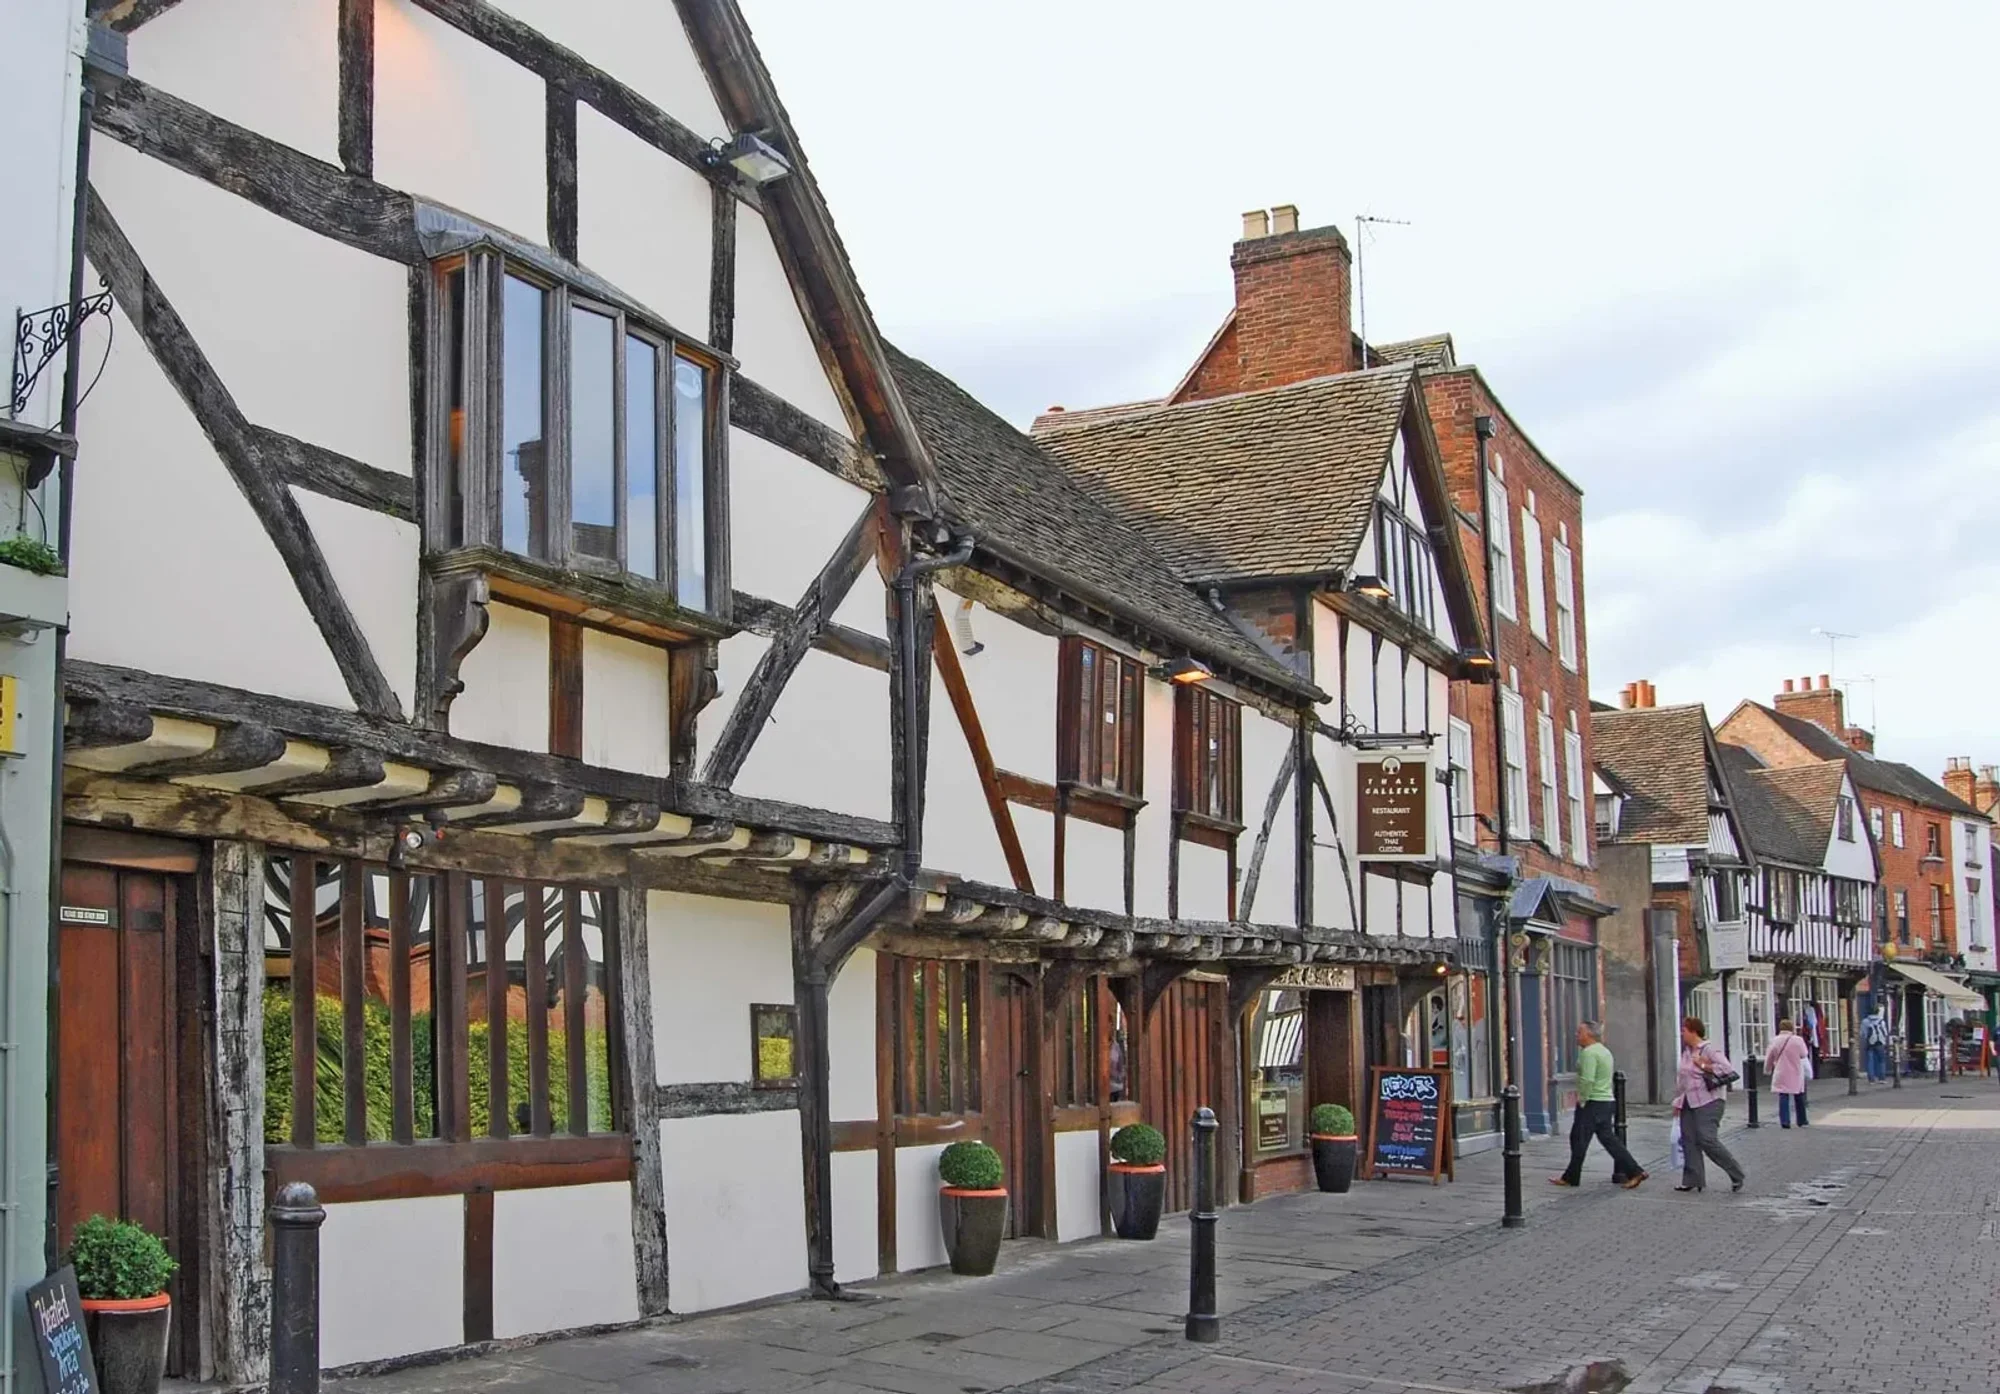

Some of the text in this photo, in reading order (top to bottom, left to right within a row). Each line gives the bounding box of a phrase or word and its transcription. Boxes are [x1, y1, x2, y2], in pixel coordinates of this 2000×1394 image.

[1365, 787, 1418, 795] GALLERY
[1374, 830, 1409, 838] AUTHENTIC
[34, 1284, 70, 1336] Heated
[47, 1321, 83, 1358] Smoking
[57, 1350, 79, 1382] Area
